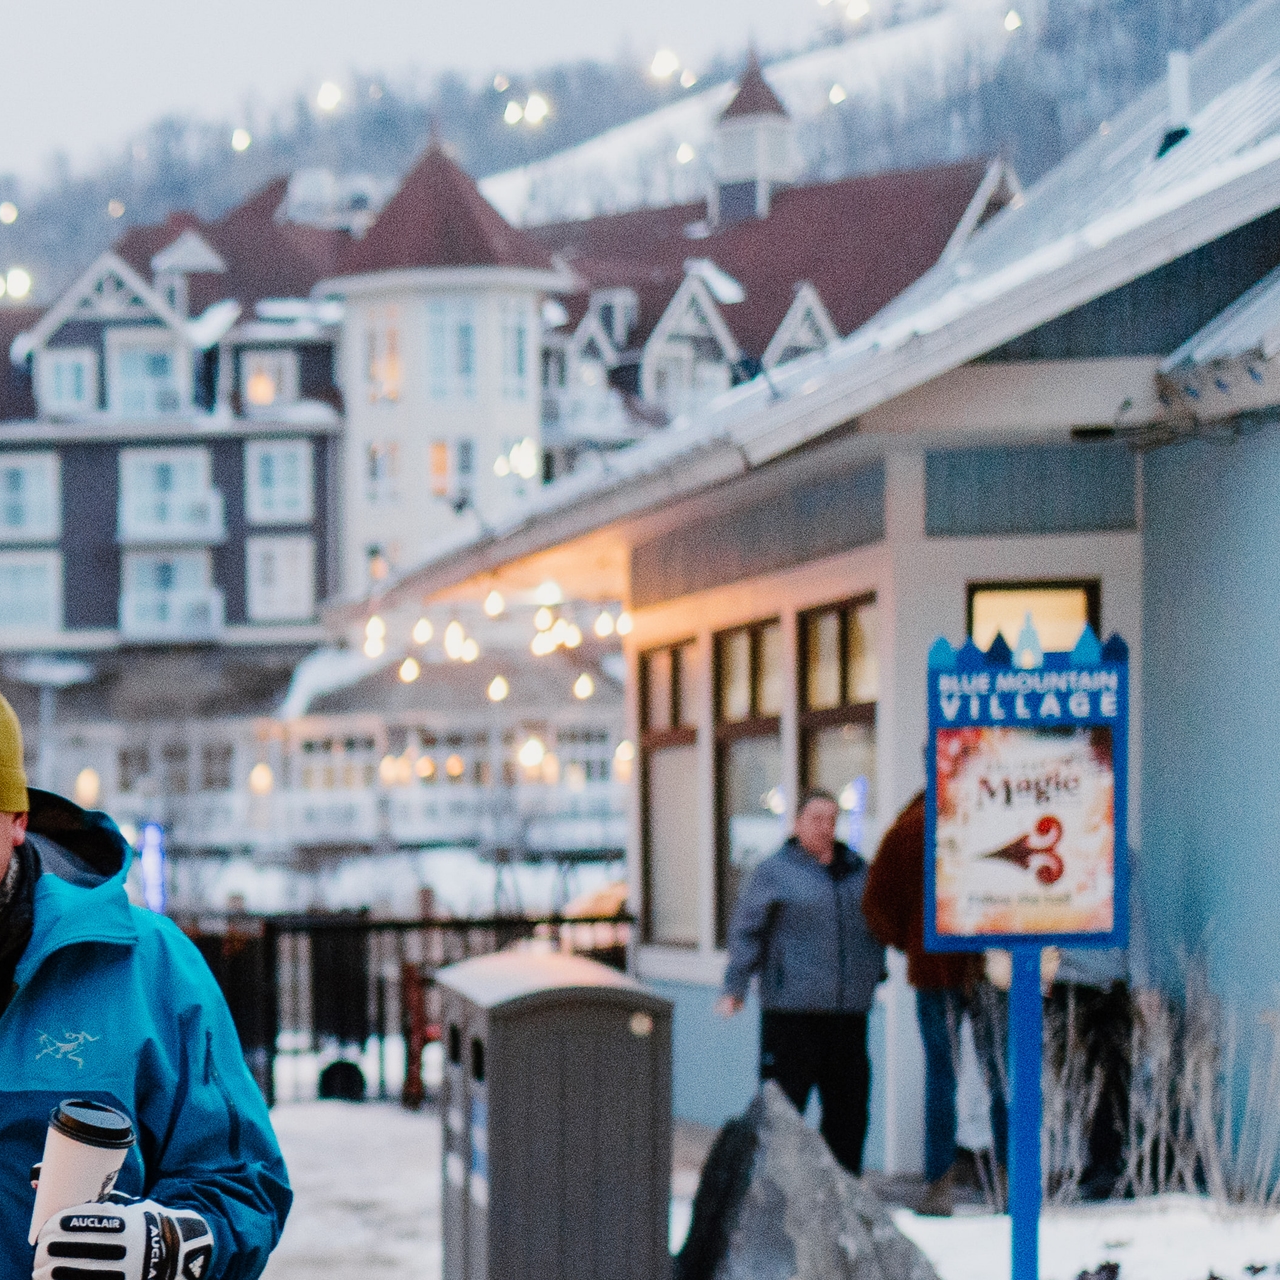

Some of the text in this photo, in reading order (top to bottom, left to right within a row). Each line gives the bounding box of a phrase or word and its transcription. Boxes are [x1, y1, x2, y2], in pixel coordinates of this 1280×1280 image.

[995, 671, 1117, 692] MOUNTAIN
[940, 692, 1118, 720] VILLAGE
[978, 770, 1080, 805] Magic
[70, 1217, 120, 1229] AUCLAIR
